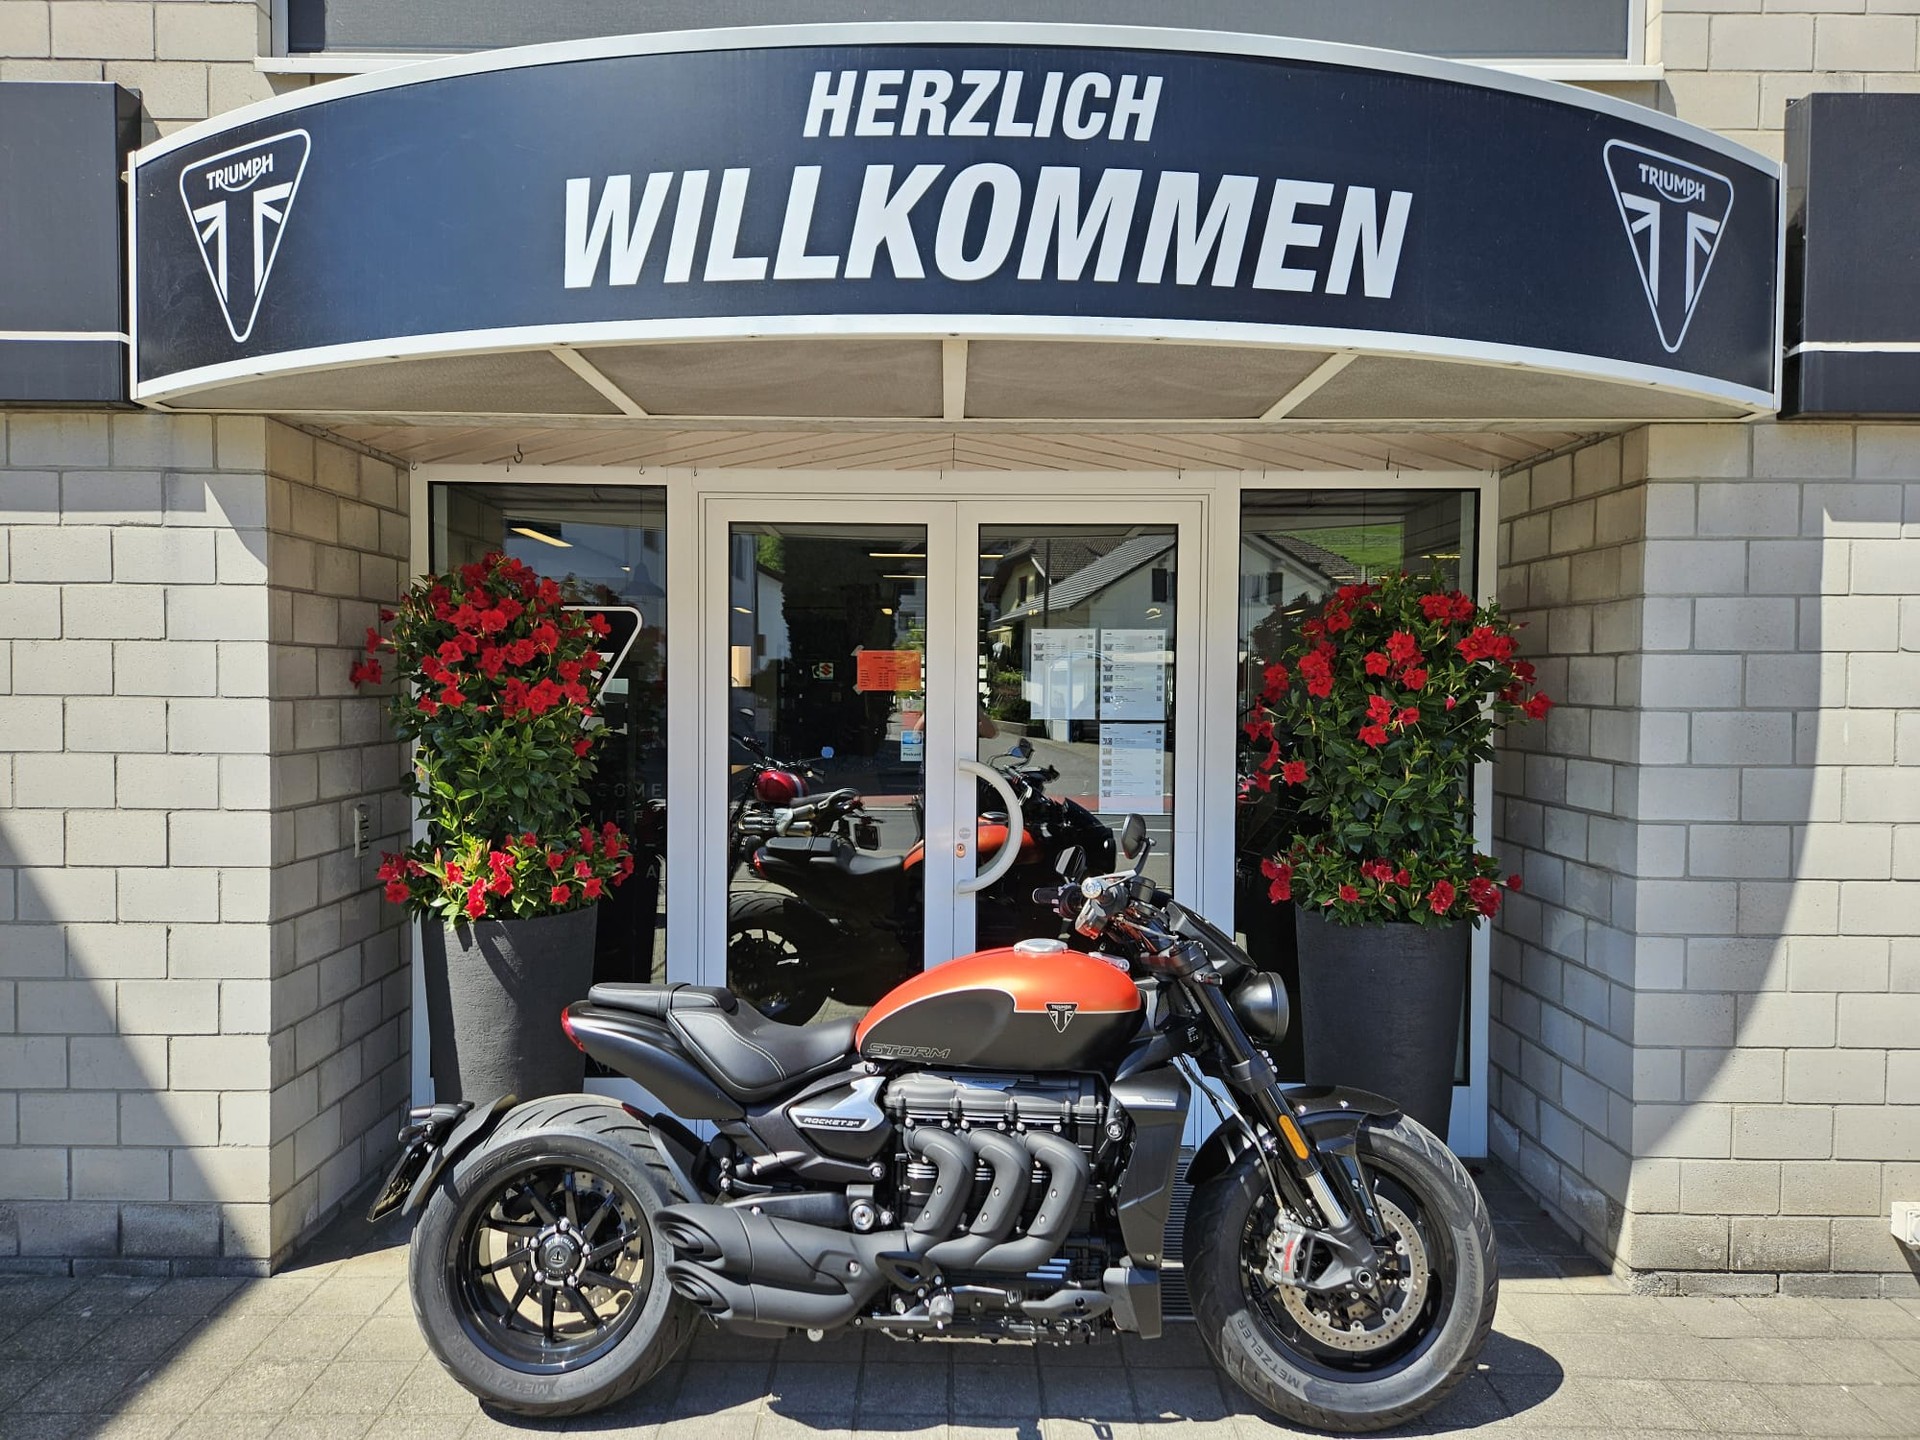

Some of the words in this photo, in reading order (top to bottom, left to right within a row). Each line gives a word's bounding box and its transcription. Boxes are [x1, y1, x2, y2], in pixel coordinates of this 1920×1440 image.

[802, 69, 1163, 142] HERZLICH
[206, 153, 274, 193] TRIUMPH
[1638, 163, 1705, 204] TRIUMPH
[563, 162, 1413, 300] WILLKOMMEN
[868, 1043, 951, 1059] STORM
[803, 1117, 847, 1126] ROCKET
[1237, 1317, 1301, 1388] METZELER
